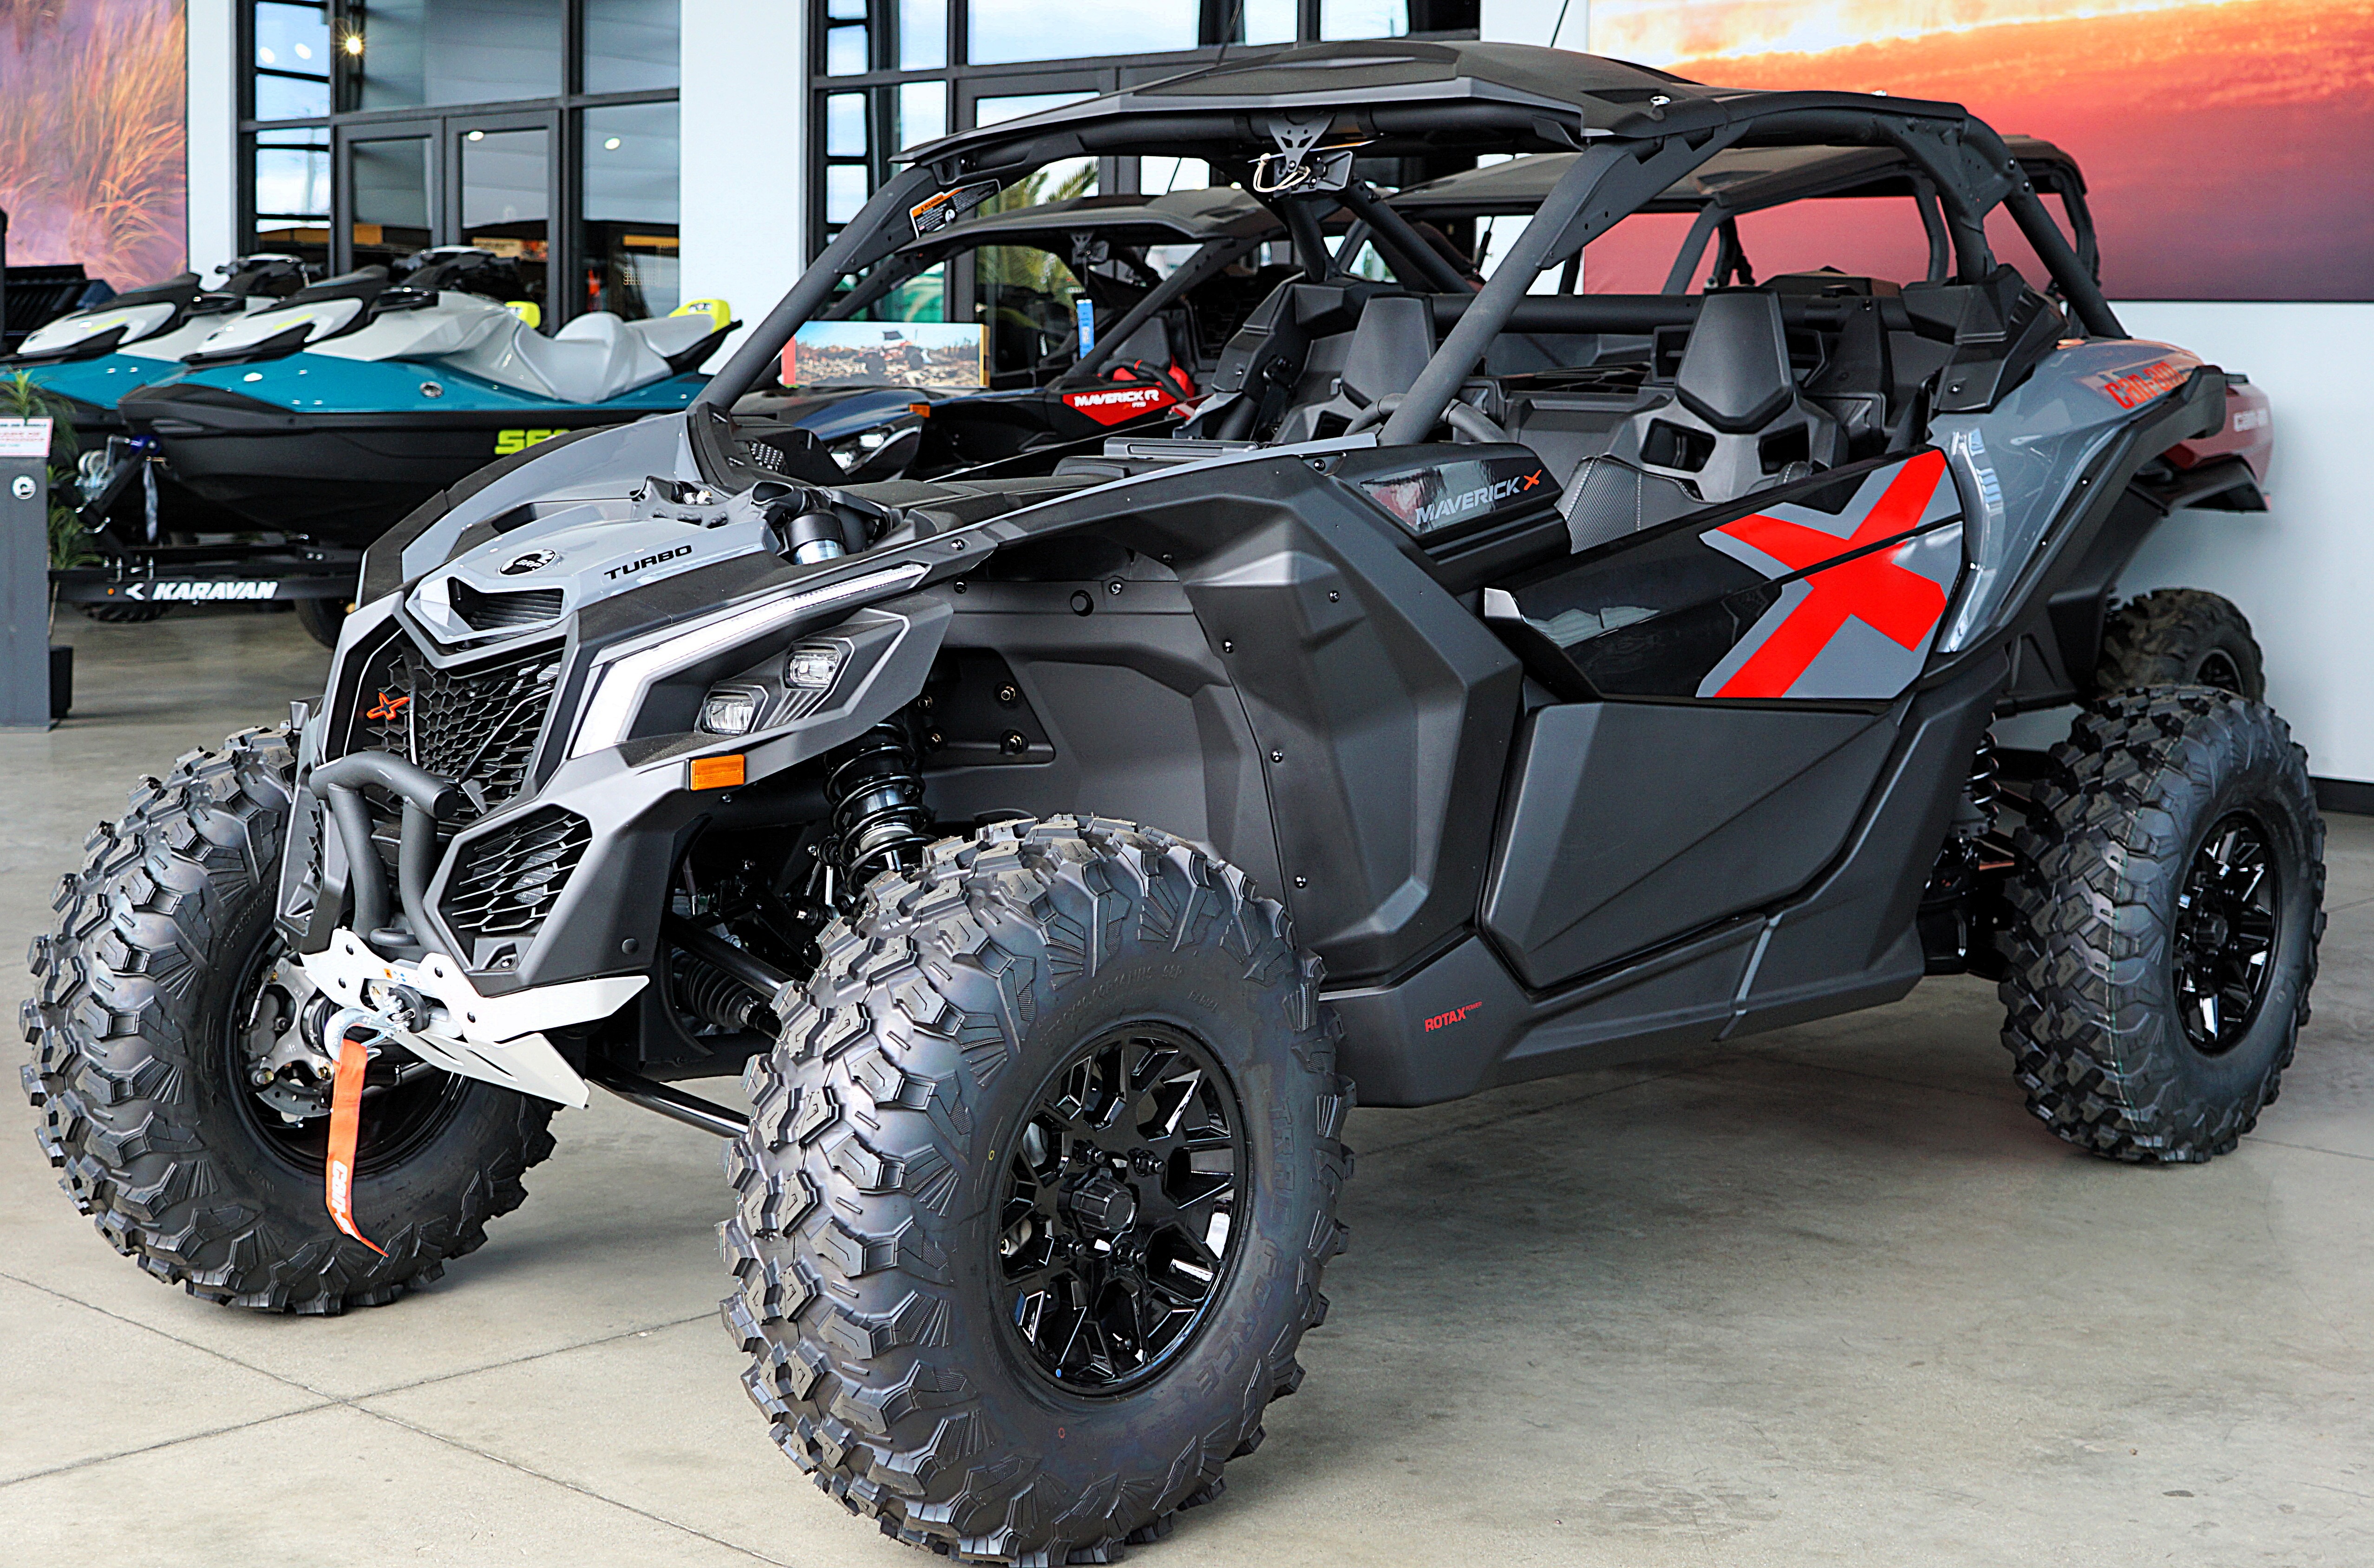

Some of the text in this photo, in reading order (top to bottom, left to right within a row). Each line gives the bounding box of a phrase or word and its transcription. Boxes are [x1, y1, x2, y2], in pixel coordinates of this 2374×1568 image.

[1073, 390, 1144, 407] MAVERICK
[494, 428, 570, 455] SE
[1415, 476, 1520, 525] MAVERICK
[515, 559, 543, 568] BRP
[604, 545, 692, 580] TURBO
[152, 581, 278, 600] KARAVAN
[1425, 1001, 1482, 1032] ROTAX POWER
